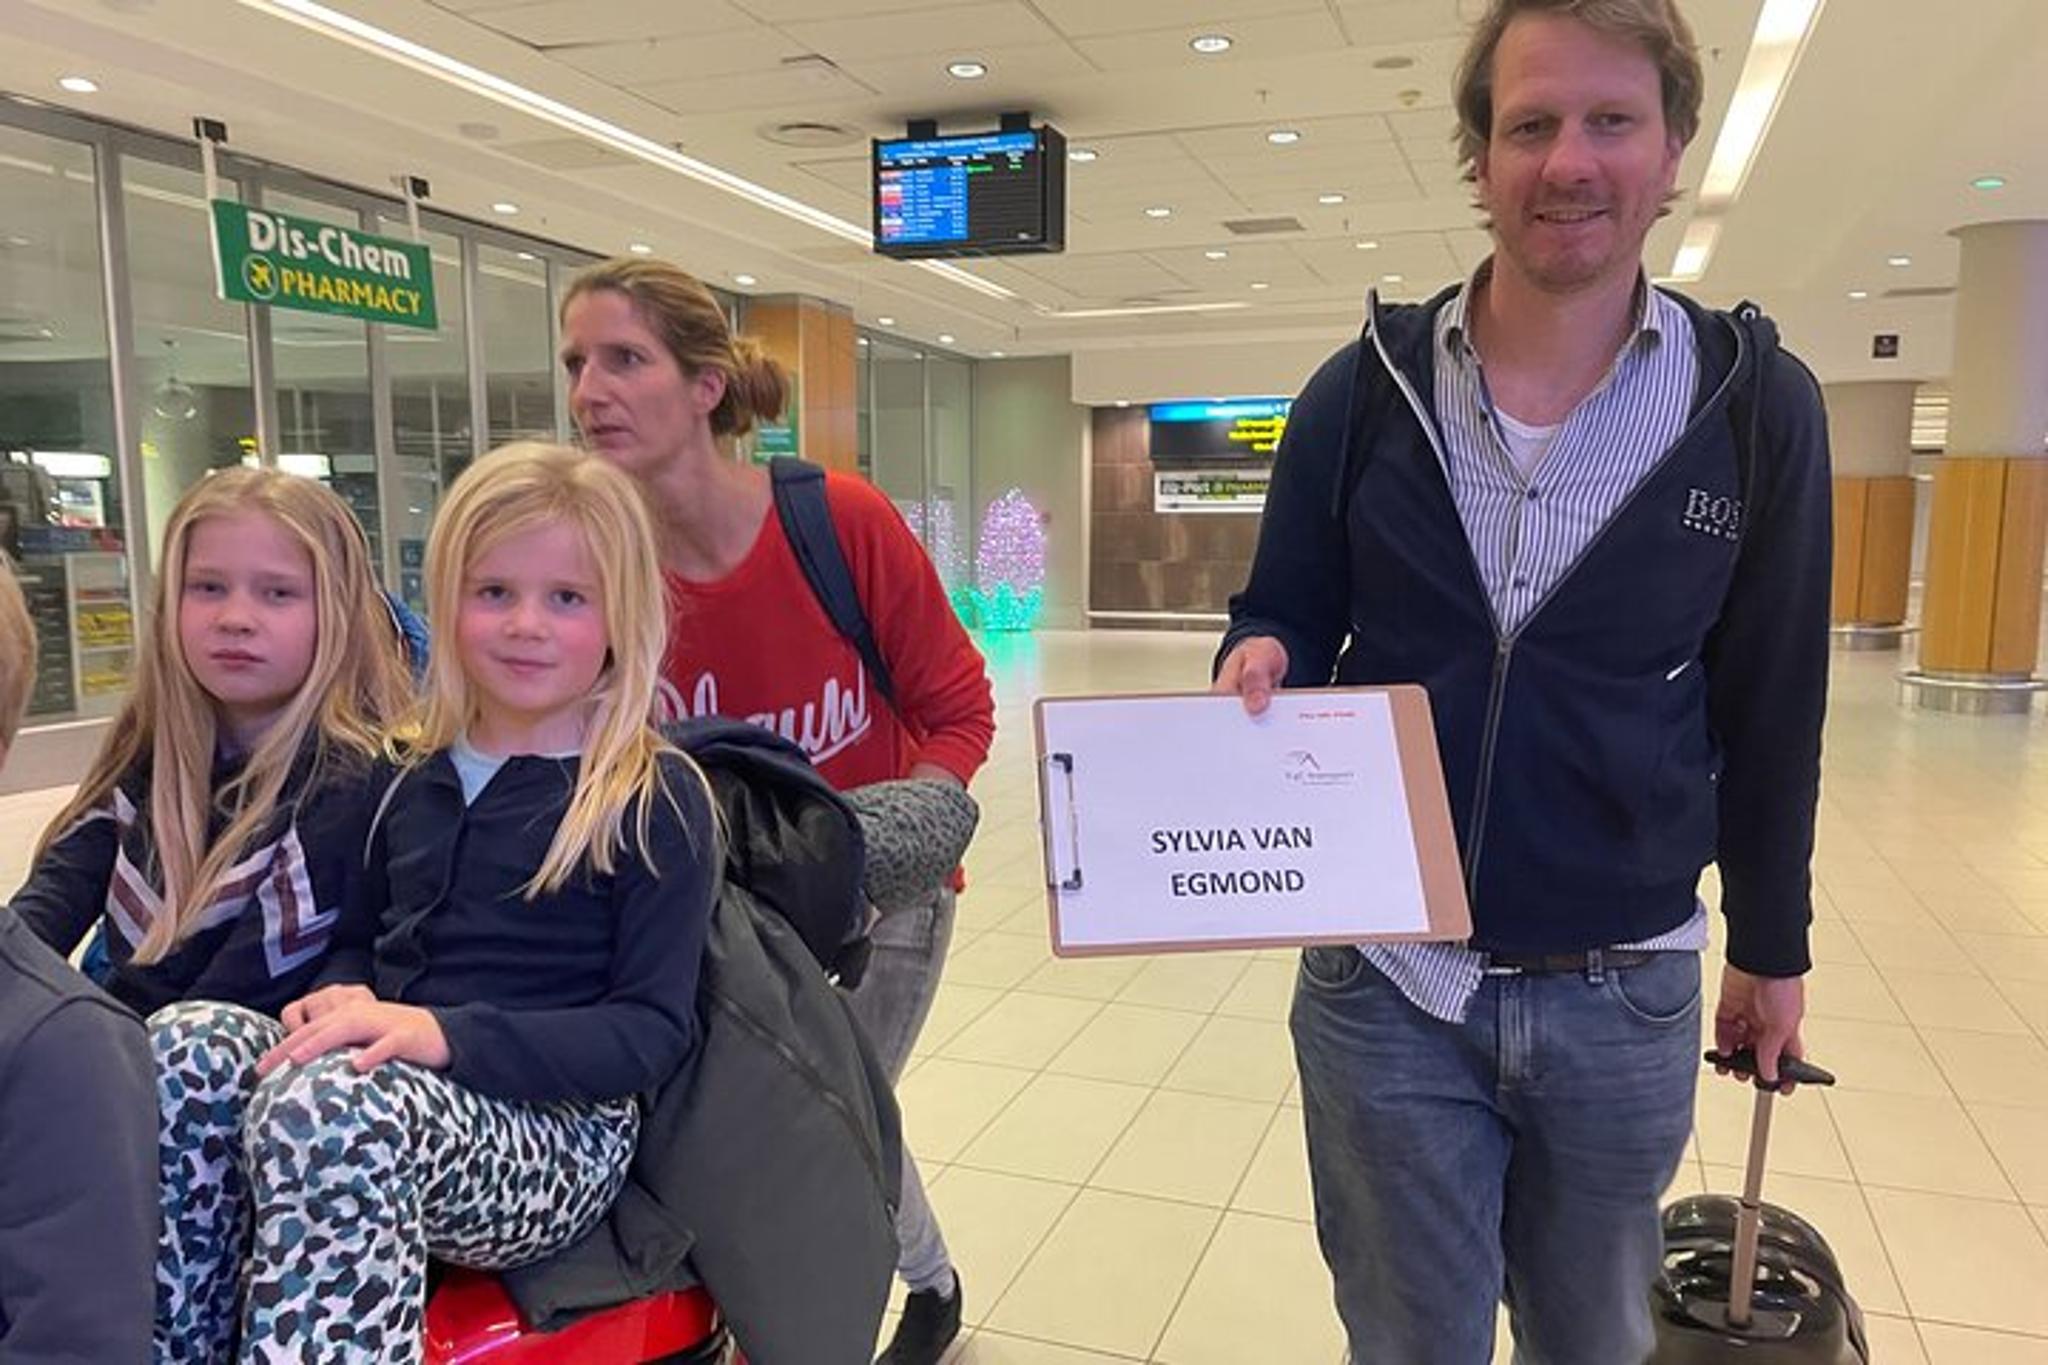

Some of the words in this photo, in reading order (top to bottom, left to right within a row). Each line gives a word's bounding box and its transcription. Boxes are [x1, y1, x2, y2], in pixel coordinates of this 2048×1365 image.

[247, 211, 411, 280] Dis-Chem
[281, 268, 421, 315] PHARMACY
[1152, 829, 1246, 853] SYLVIA
[1251, 827, 1313, 849] VAN
[1171, 869, 1305, 897] EGMOND
